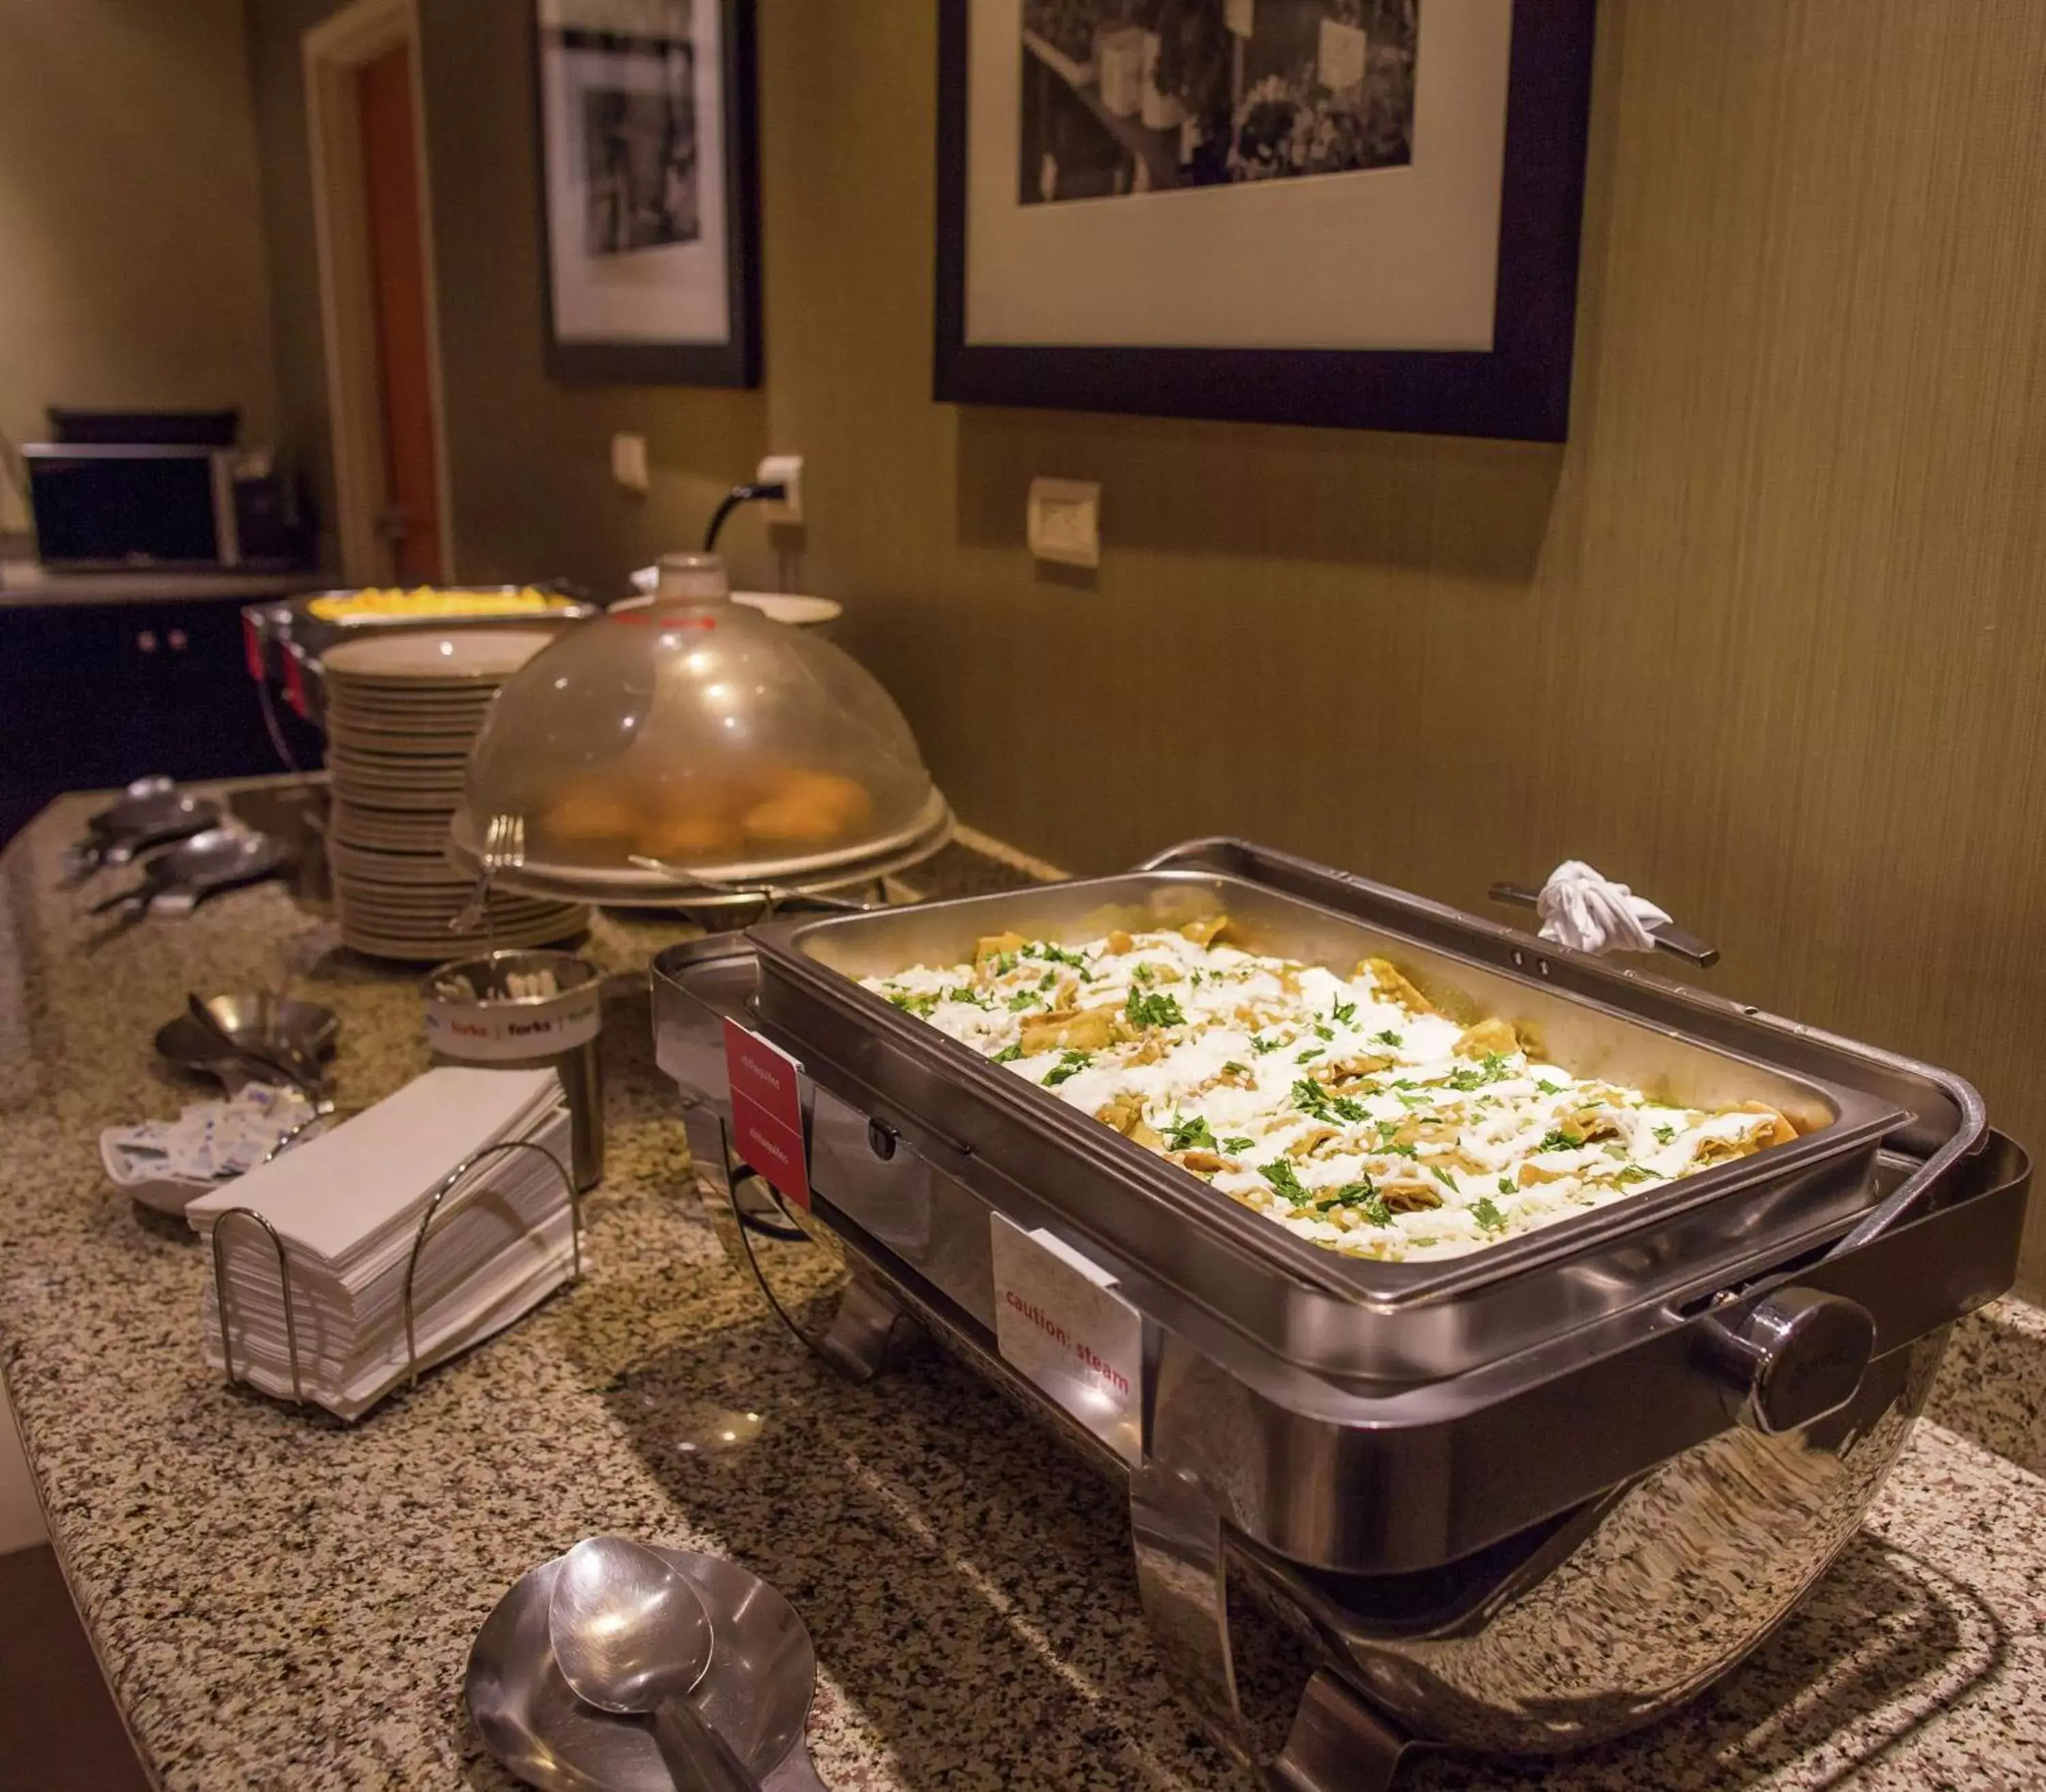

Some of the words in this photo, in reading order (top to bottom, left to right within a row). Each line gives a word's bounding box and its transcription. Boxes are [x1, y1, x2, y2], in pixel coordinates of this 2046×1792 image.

[507, 1019, 552, 1036] forks
[1007, 1289, 1071, 1349] caution:
[1076, 1342, 1129, 1395] steam
